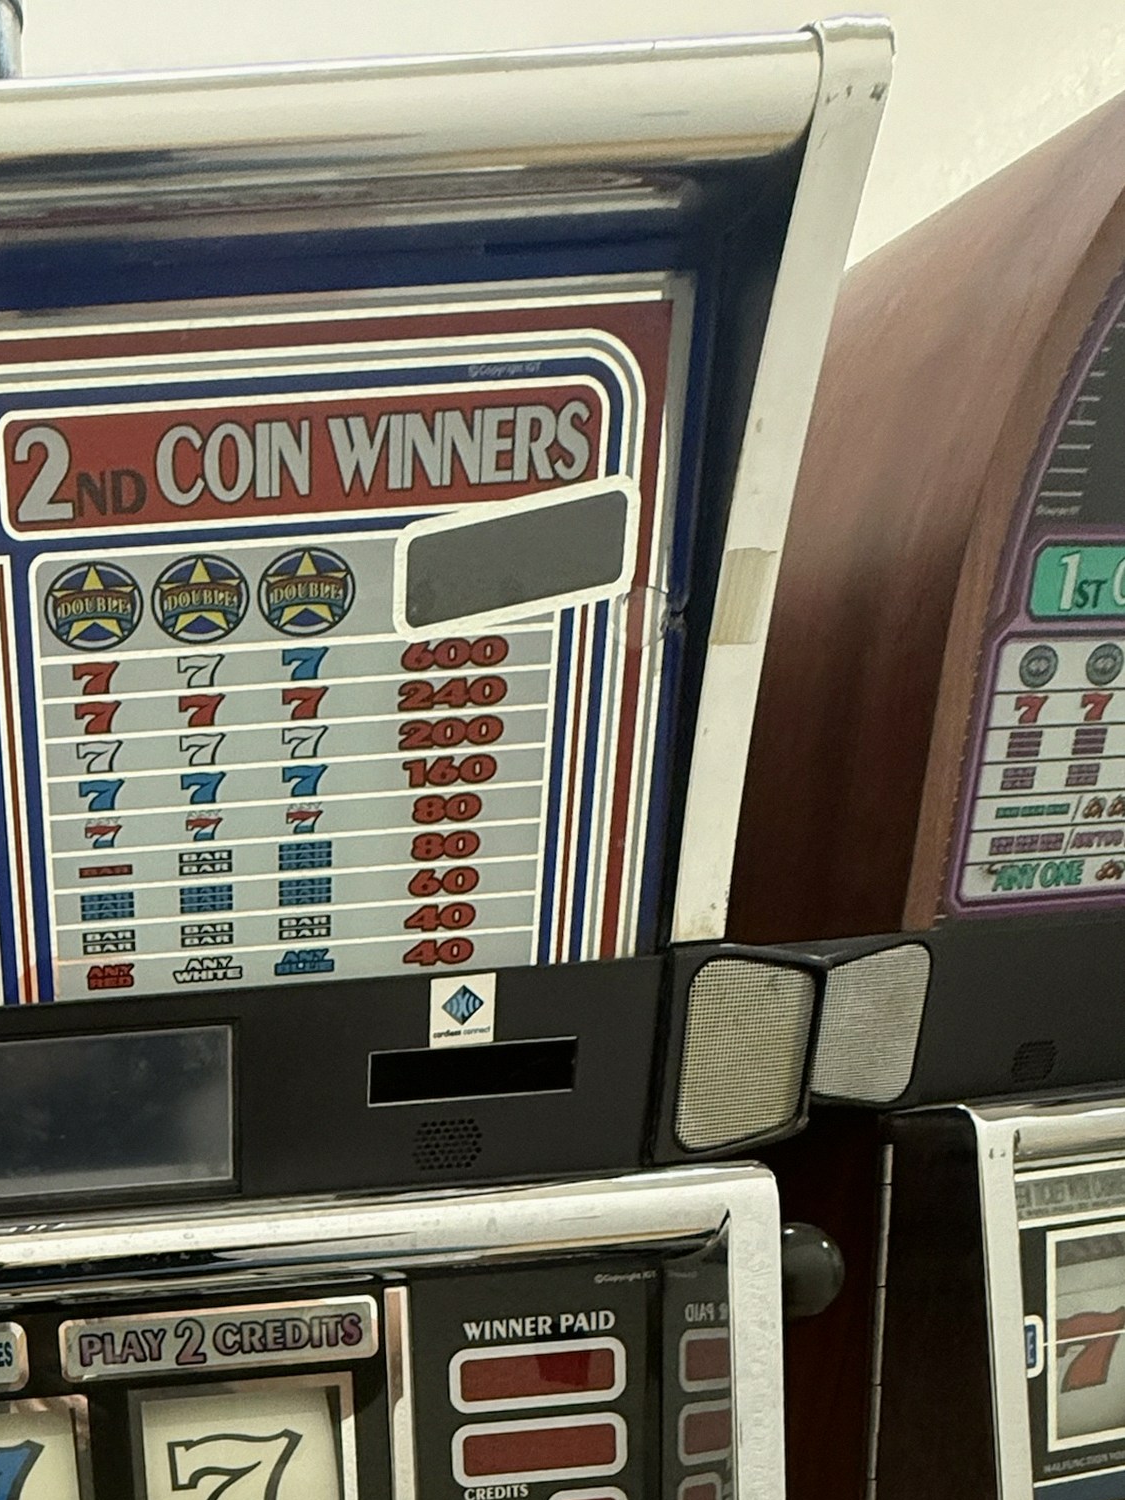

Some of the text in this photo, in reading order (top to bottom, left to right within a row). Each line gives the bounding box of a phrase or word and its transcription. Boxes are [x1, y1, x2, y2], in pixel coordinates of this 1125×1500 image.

[155, 419, 311, 506] COIN
[328, 400, 591, 495] WINNERS
[401, 635, 509, 671] 600
[398, 675, 507, 712] 240
[398, 714, 503, 750] 200
[402, 753, 497, 788] 160
[412, 792, 482, 824] 80
[411, 830, 480, 861] 80
[408, 866, 479, 897] 60
[1040, 860, 1085, 888] ONE
[404, 902, 476, 932] 40
[186, 937, 474, 970] ANY 40
[173, 966, 243, 984] WHITE
[79, 1312, 364, 1368] PLAY 2 CREDITS
[463, 1310, 615, 1341] WINNER PAID
